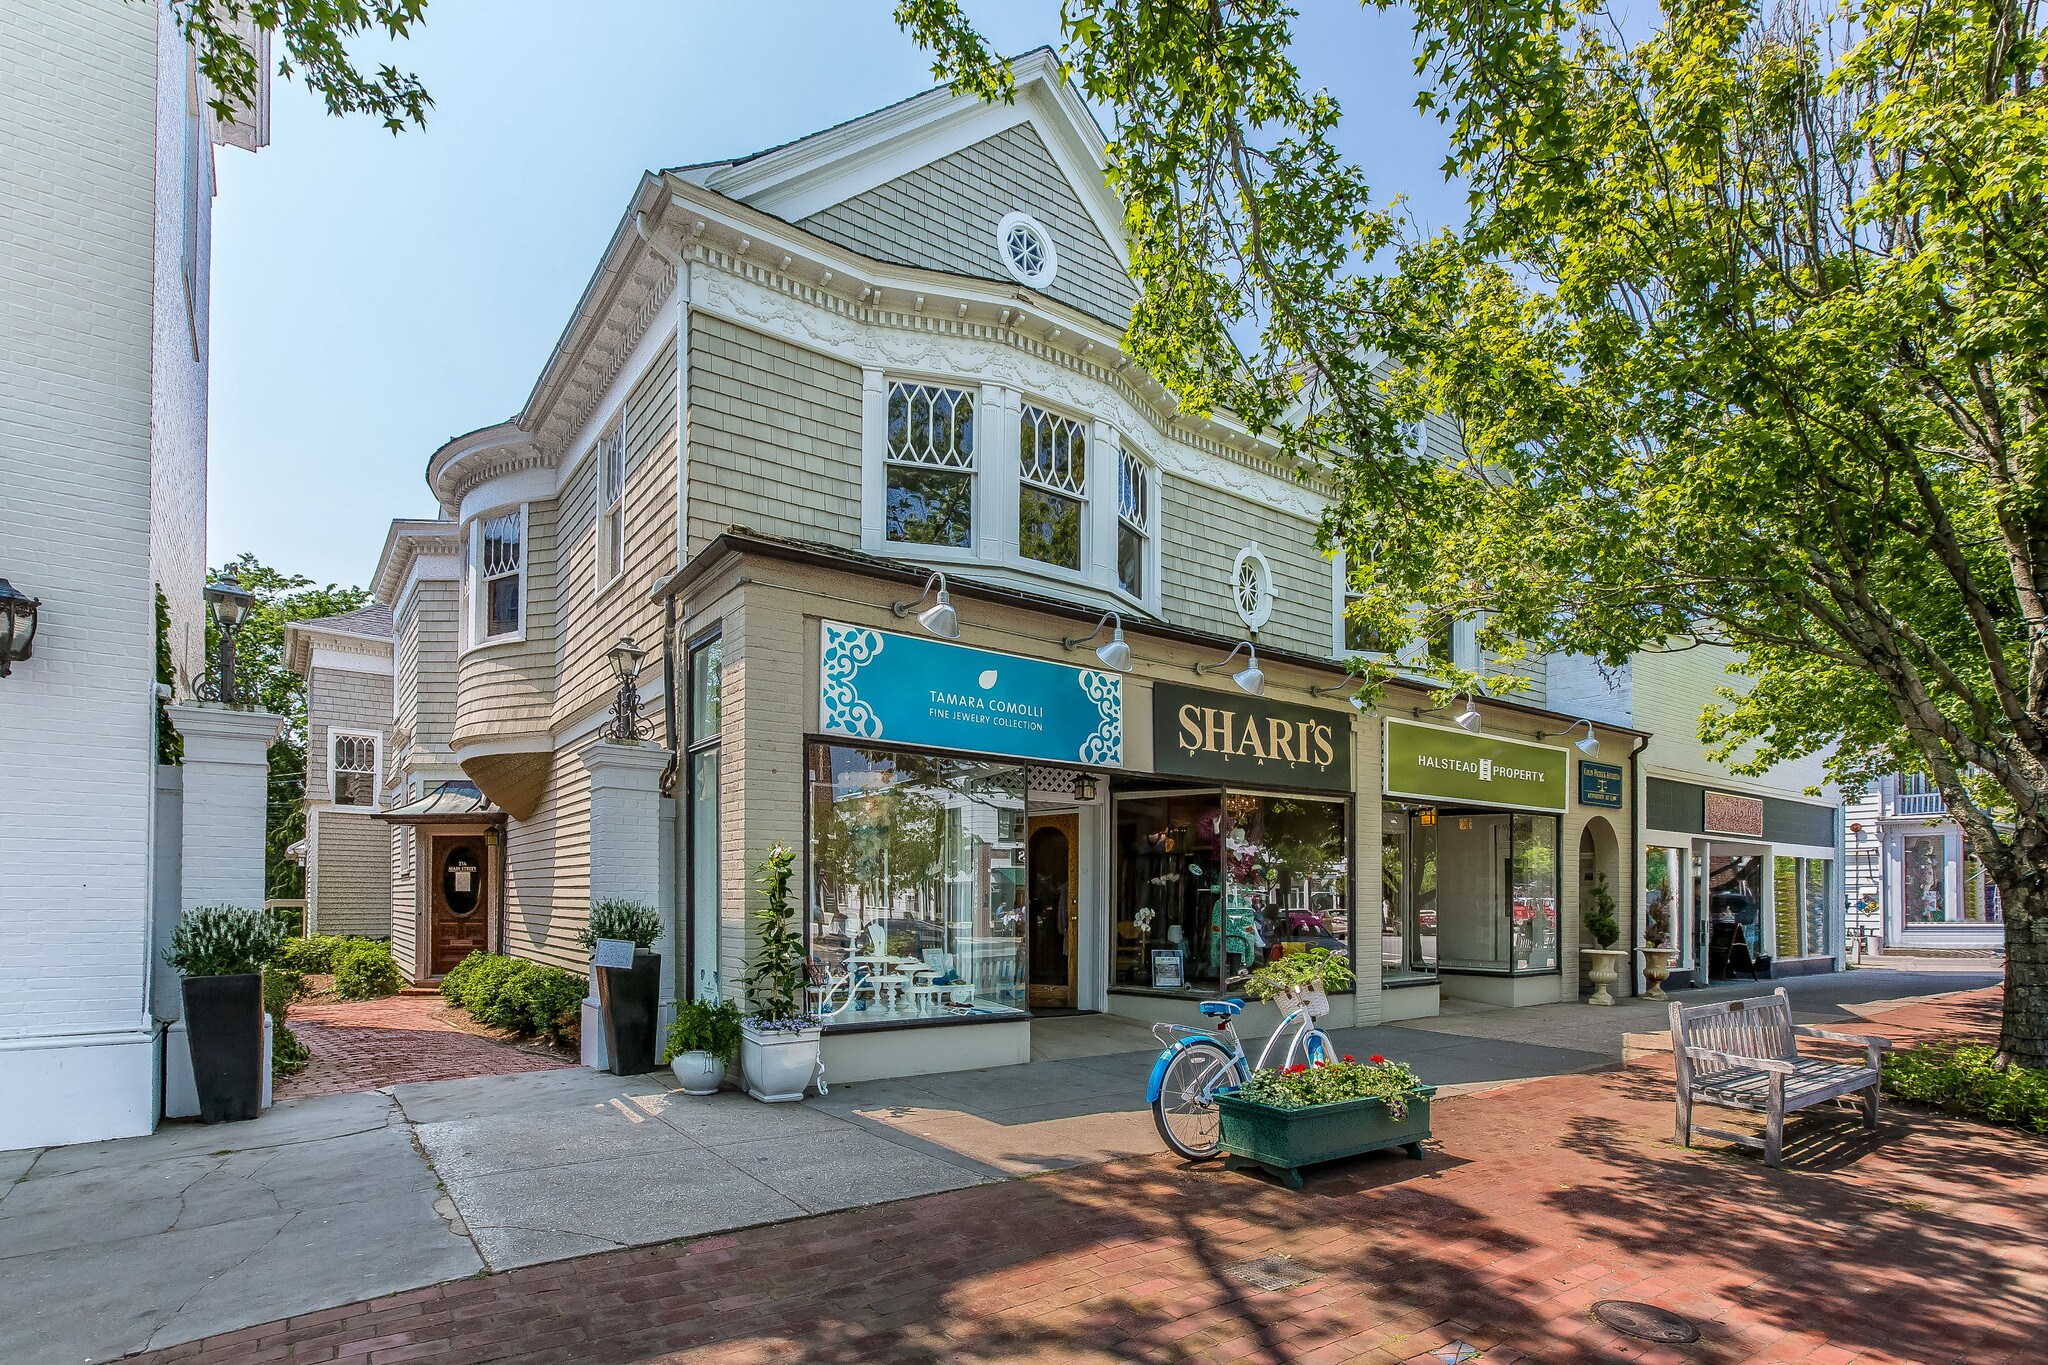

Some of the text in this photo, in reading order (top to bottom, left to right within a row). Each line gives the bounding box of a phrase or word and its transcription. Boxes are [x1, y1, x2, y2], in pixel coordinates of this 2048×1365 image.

[929, 690, 1043, 718] TAMARA COMOLLI
[929, 708, 1043, 732] FINE JEWELRY COLLECTION
[1178, 703, 1334, 767] SHARI'S
[1418, 754, 1544, 782] HALSTEAD PROPERTY
